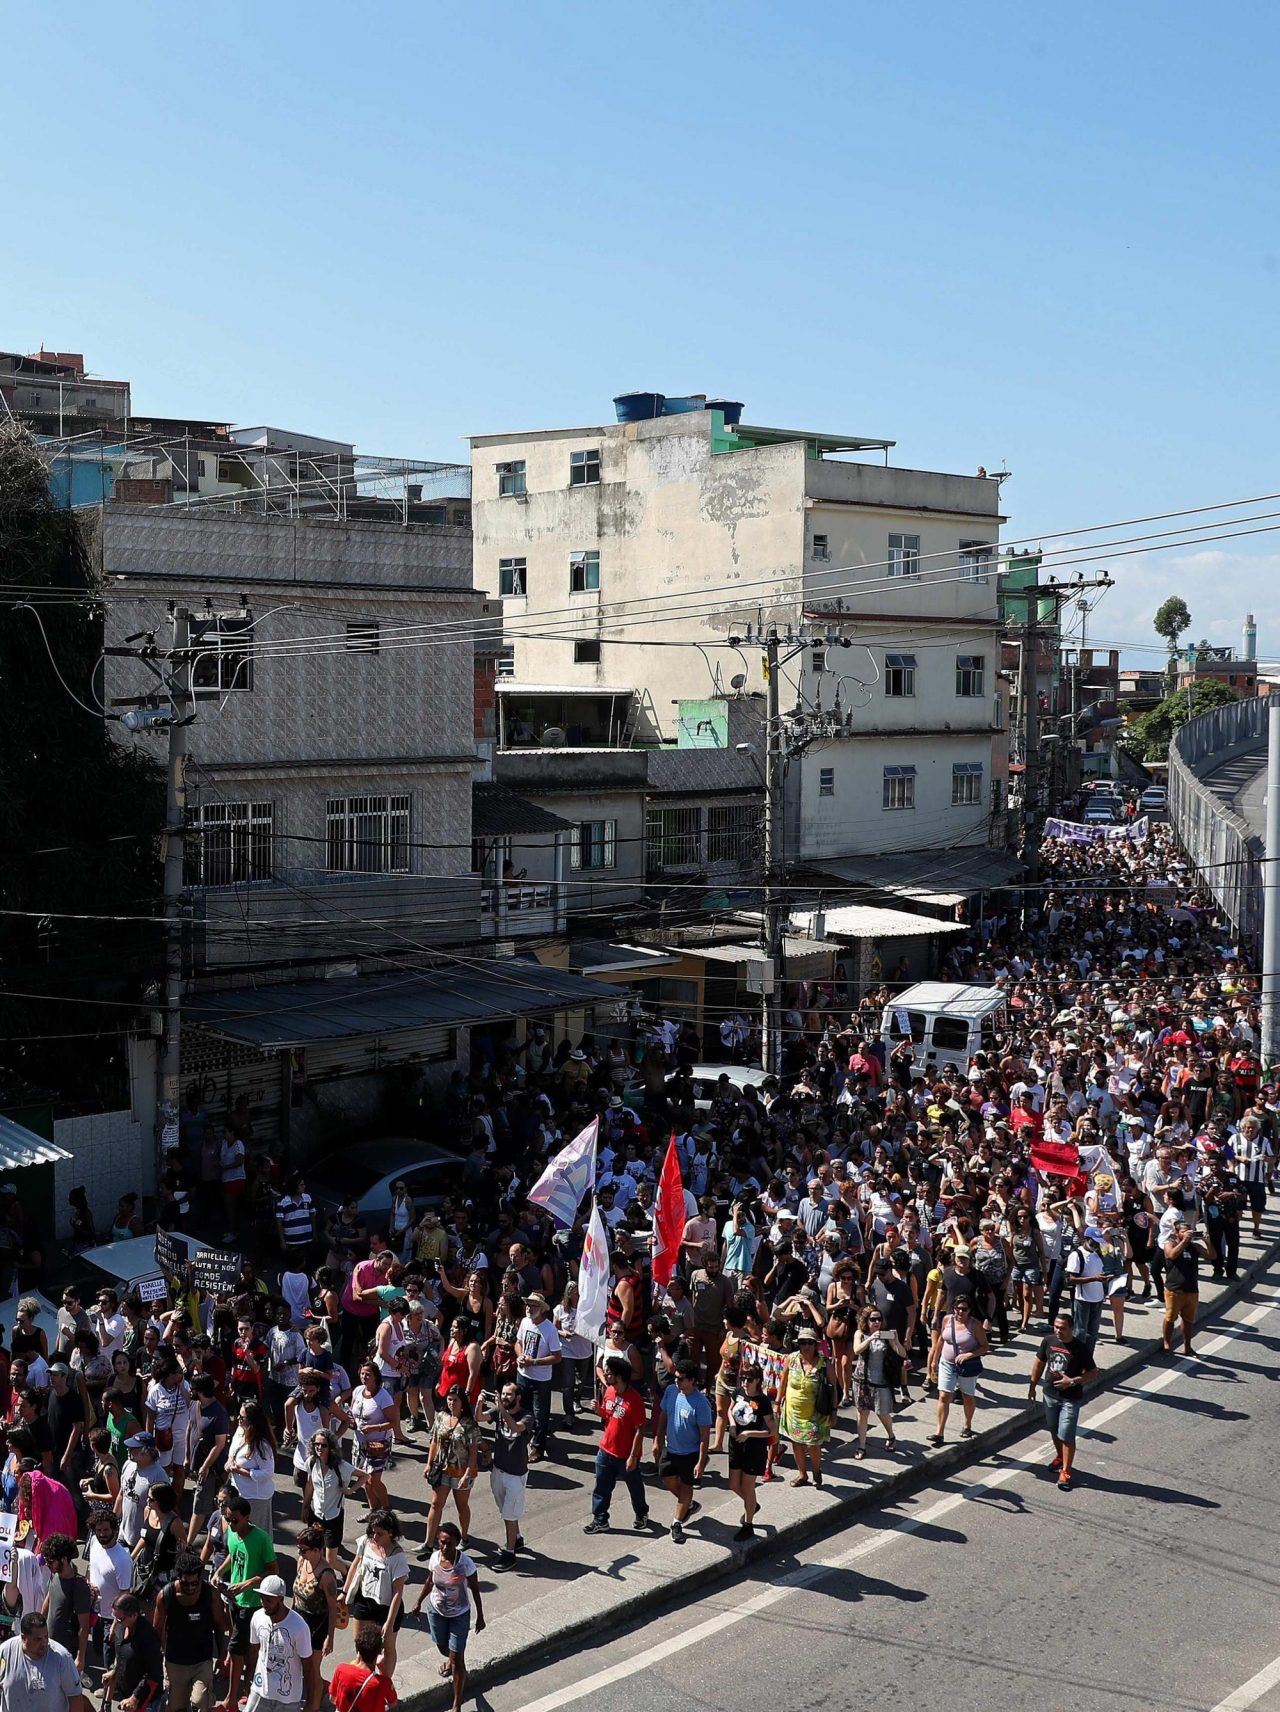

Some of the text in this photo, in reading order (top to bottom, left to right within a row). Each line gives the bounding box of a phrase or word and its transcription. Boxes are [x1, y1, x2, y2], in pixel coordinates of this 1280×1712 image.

[196, 1251, 228, 1262] MARIELLE
[195, 1262, 212, 1270] LUTA
[221, 1262, 236, 1272] NÓS
[195, 1271, 221, 1281] SOMOS
